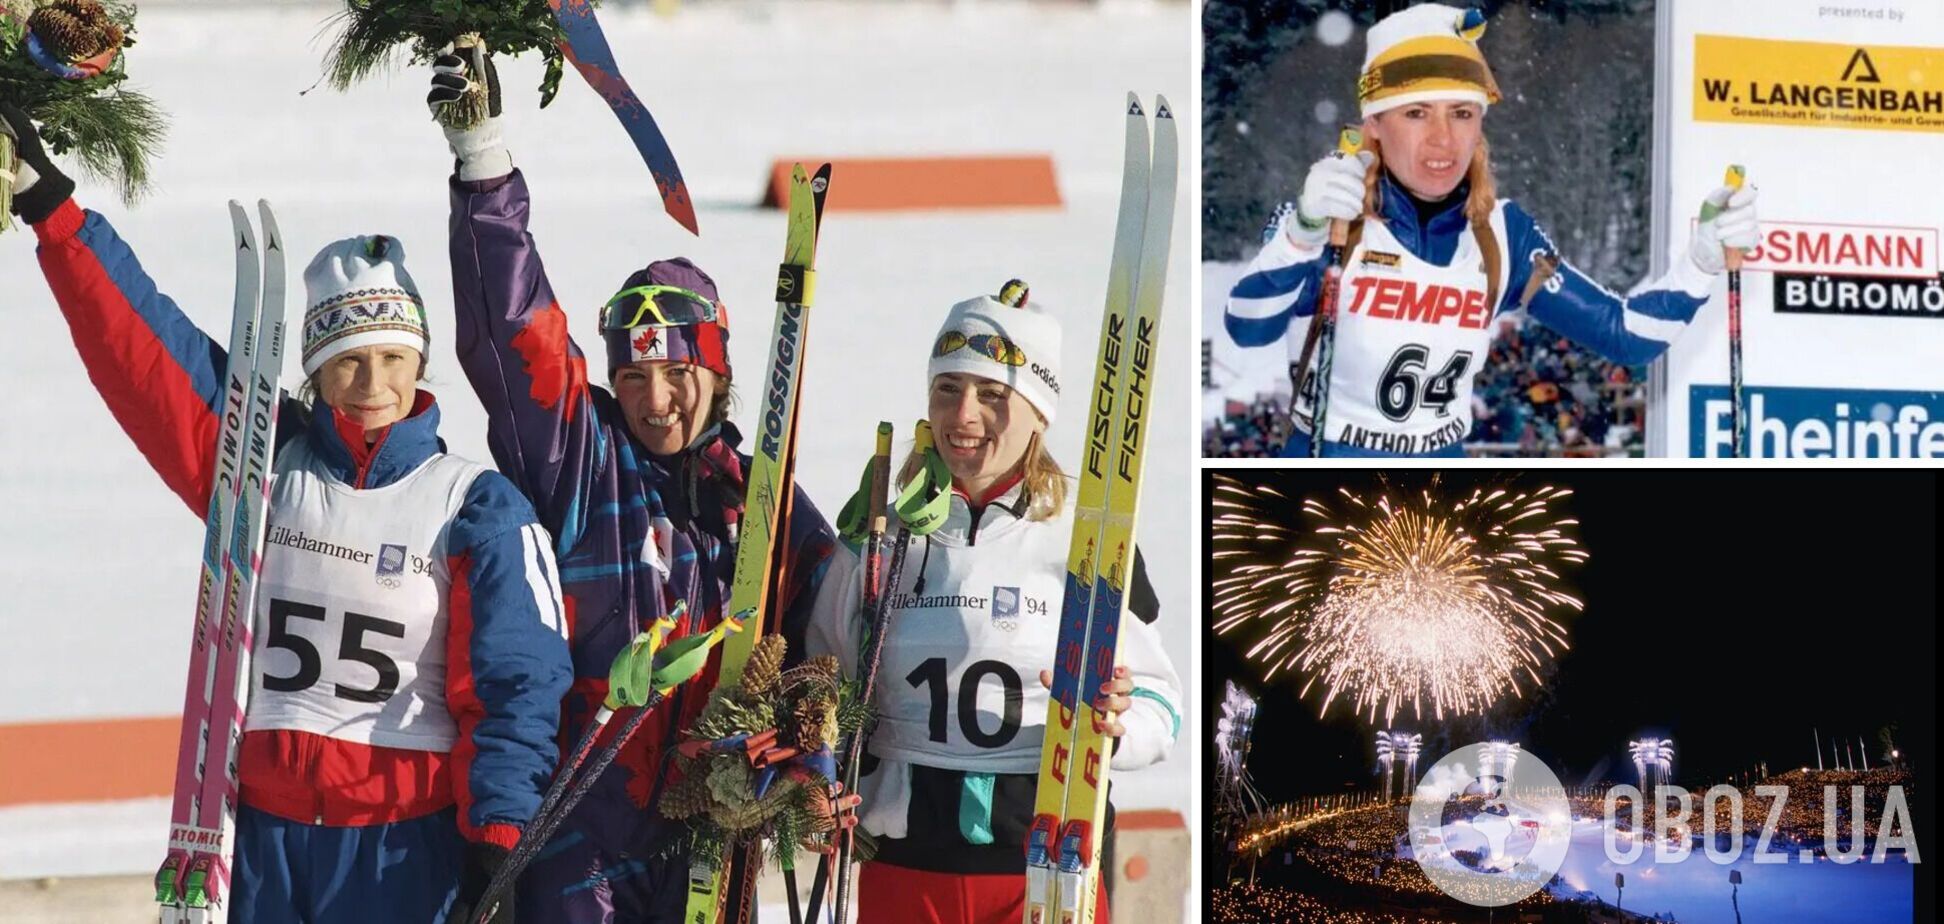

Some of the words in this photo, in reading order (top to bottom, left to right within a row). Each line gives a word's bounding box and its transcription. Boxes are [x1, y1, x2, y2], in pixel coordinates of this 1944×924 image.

[1818, 6, 1884, 20] presented
[1888, 9, 1905, 22] by
[1703, 78, 1739, 104] W.
[1750, 82, 1943, 113] LANGENBAH
[1731, 107, 1806, 121] Gesellschaft
[1810, 112, 1827, 121] für
[1830, 113, 1887, 124] Industrie-
[1890, 116, 1913, 125] und
[1349, 277, 1490, 330] TEMPE
[1785, 275, 1944, 312] BÜROMÖ
[1031, 362, 1060, 394] adida
[1088, 312, 1125, 480] FISCHER
[1118, 315, 1155, 484] FISCHER
[1376, 343, 1473, 422] 64
[219, 373, 244, 490] ATOMIC
[247, 373, 272, 490] ATOMIC
[265, 524, 374, 565] Lillehammer
[410, 554, 434, 578] '94
[197, 574, 212, 652] SKATING
[225, 574, 241, 652] SKATING
[890, 592, 988, 610] illehammer
[1024, 597, 1048, 616] '94
[262, 598, 405, 702] 55
[905, 657, 1023, 749] 10
[171, 828, 224, 847] ATOMIC
